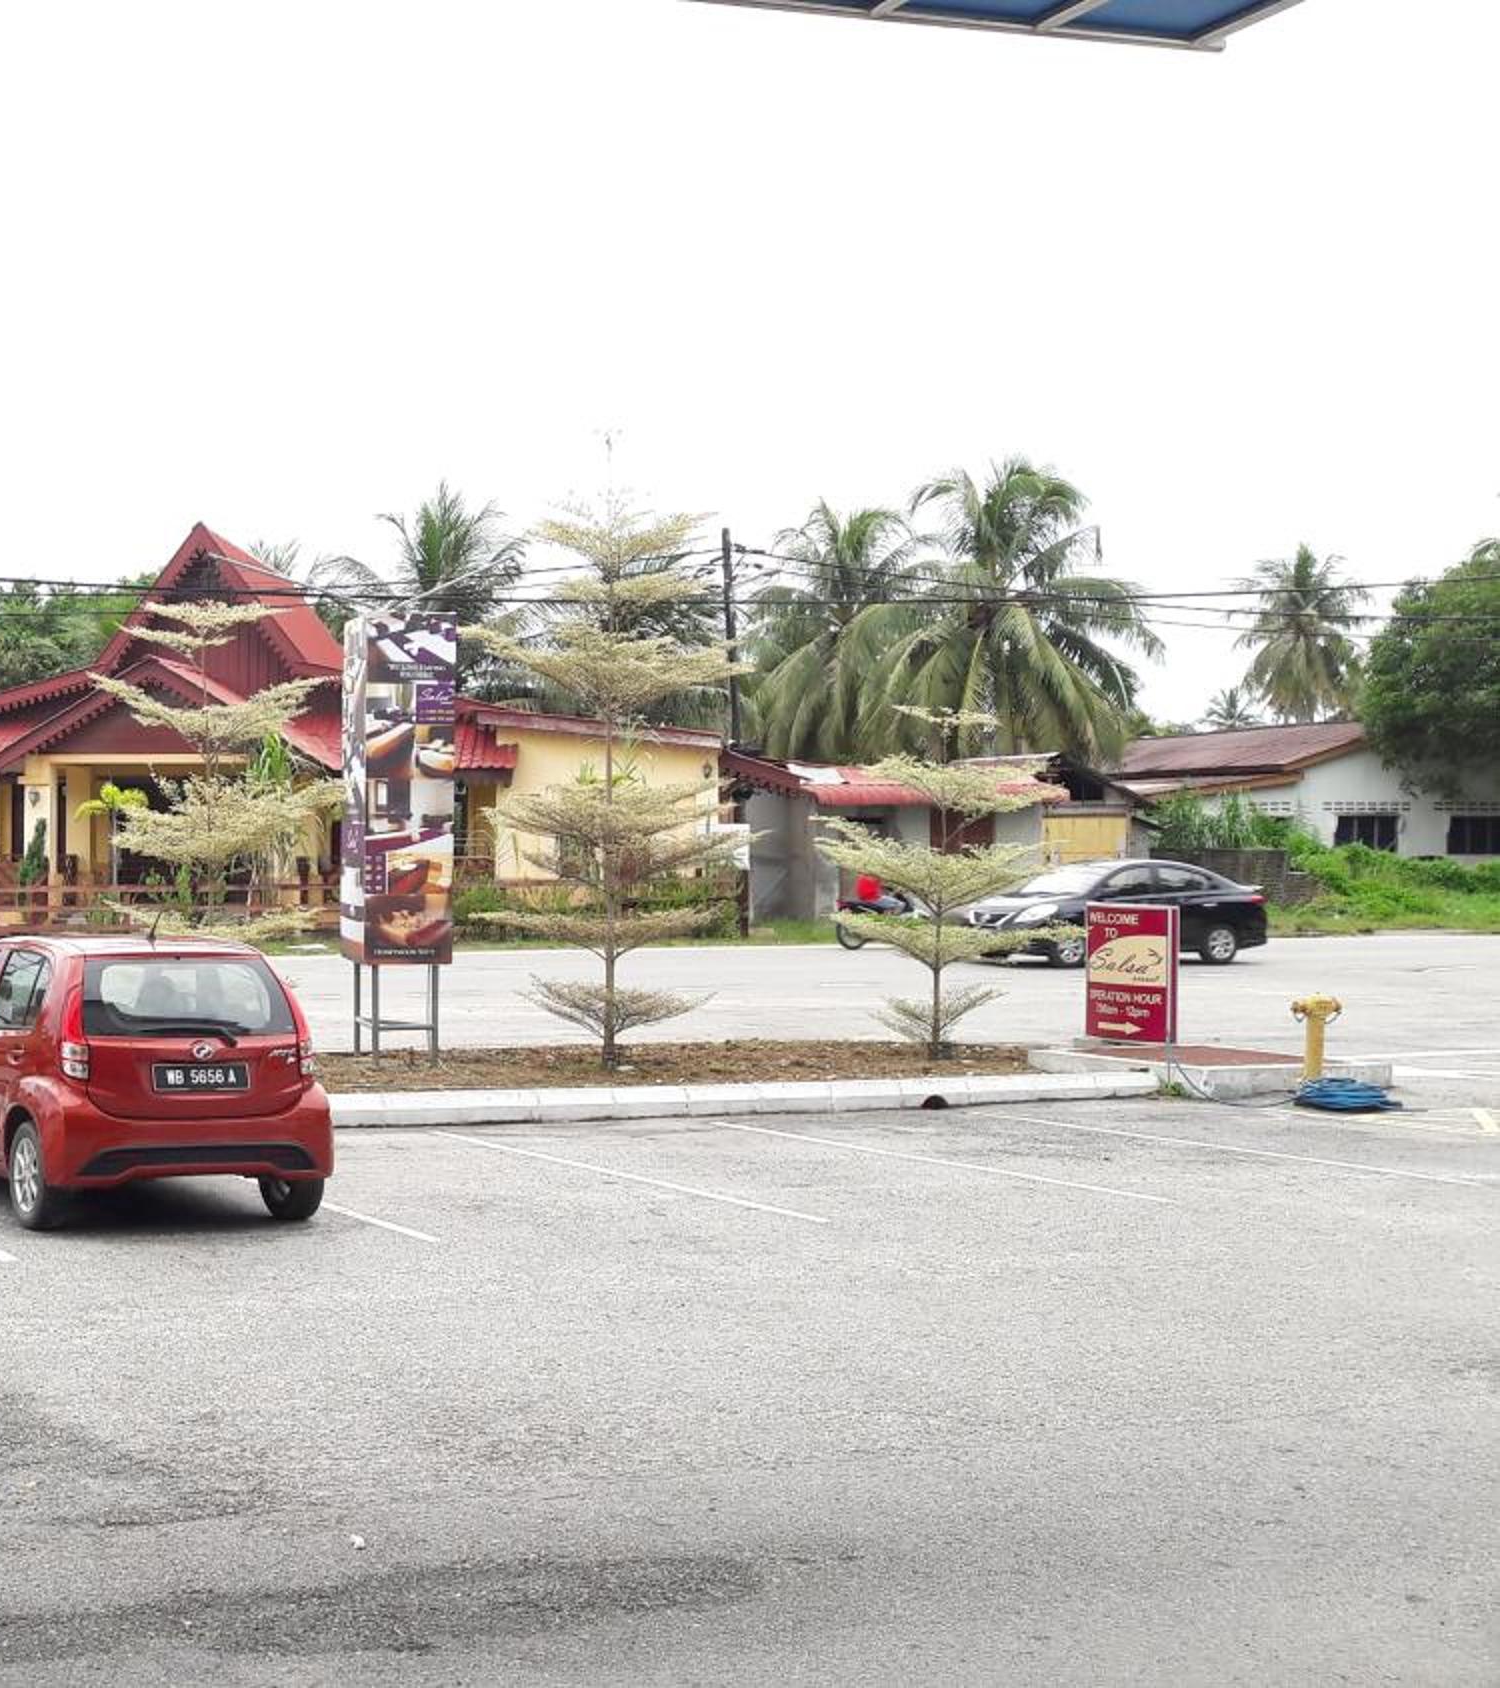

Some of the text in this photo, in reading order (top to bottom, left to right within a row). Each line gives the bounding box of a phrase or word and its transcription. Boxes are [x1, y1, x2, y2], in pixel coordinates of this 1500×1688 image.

[1090, 911, 1139, 925] WELCOME
[1105, 927, 1118, 939] TO
[1092, 947, 1149, 974] Salsa
[1090, 989, 1163, 1005] OPERATION HOUR
[166, 1067, 236, 1085] WB 5656 A
